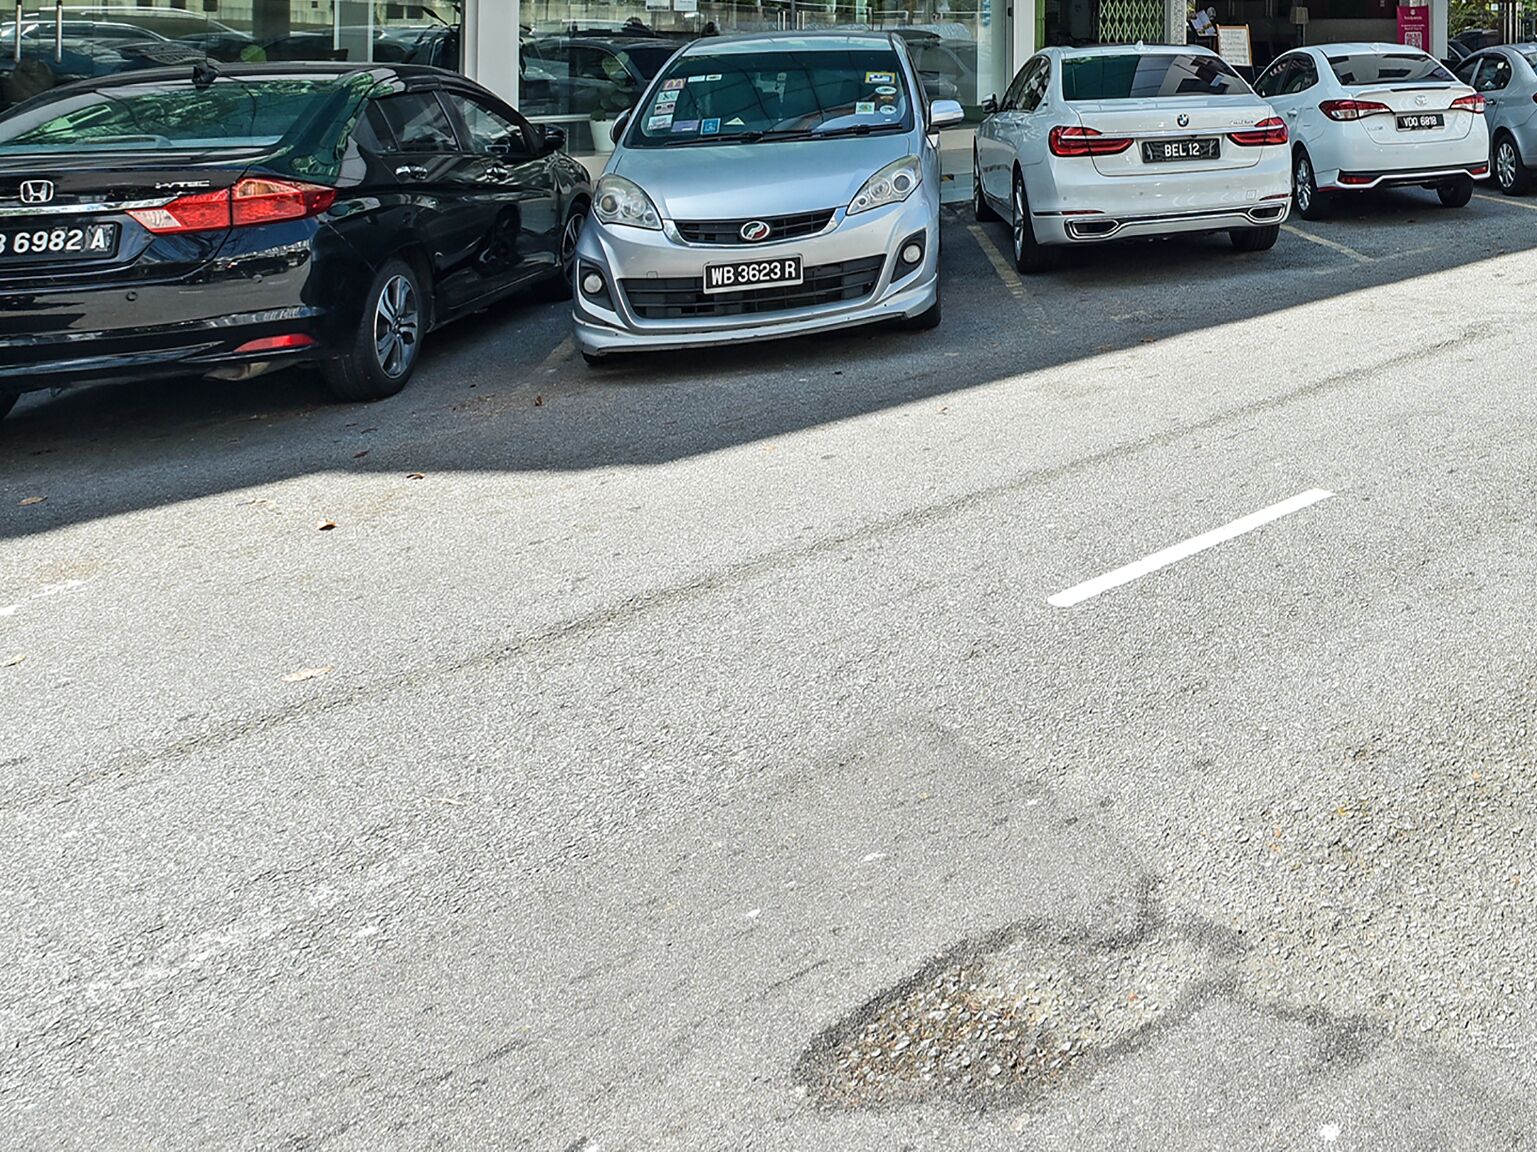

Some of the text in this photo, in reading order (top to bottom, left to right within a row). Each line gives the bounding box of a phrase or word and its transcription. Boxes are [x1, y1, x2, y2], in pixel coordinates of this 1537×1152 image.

[1164, 142, 1200, 157] BEL 12
[14, 229, 83, 253] 6982
[90, 228, 106, 250] A
[711, 260, 796, 285] WB 3623 R
